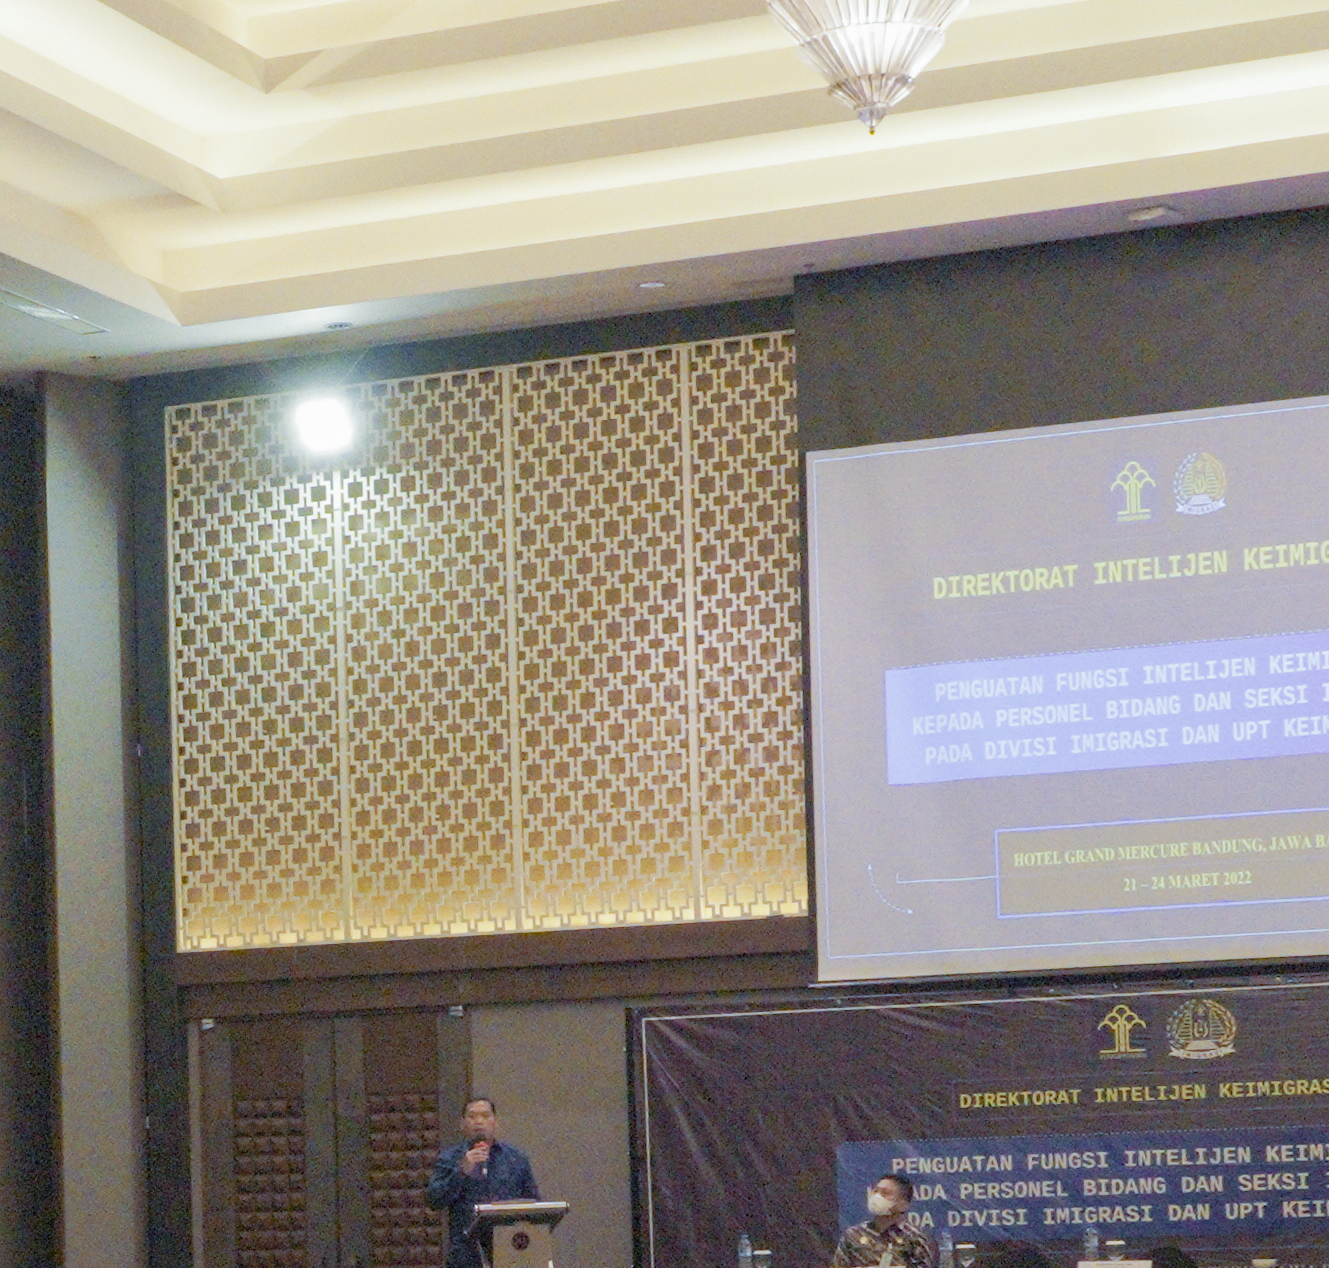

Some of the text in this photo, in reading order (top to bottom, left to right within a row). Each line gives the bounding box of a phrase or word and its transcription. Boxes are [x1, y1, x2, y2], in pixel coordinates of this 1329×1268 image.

[933, 564, 1079, 599] DIREKTORAT
[1094, 550, 1228, 584] INTELIJEN
[935, 675, 1043, 701] PENGUATAN
[1056, 668, 1129, 691] FUNGSI
[1143, 657, 1256, 685] INTELIJEN
[912, 711, 984, 735] KEPADA
[996, 703, 1093, 727] PERSONEL
[1106, 695, 1181, 719] BIDANG
[1194, 691, 1231, 712] DAN
[1244, 685, 1308, 709] SEKSI
[925, 743, 973, 764] PADA
[985, 737, 1057, 760] DIVISI
[1071, 728, 1168, 754] IMIGRASI
[1182, 723, 1219, 745] DAN
[1232, 720, 1271, 742] UPT
[1014, 851, 1061, 867] HOTEL
[1065, 847, 1115, 864] GRAND
[1119, 842, 1188, 860] MERCURE
[1192, 838, 1267, 856] BANDUNG,
[1269, 834, 1312, 851] JAWA
[1123, 878, 1137, 891] 21
[1152, 875, 1165, 890] 24
[1169, 872, 1220, 889] MARET
[1223, 871, 1252, 886] 2022
[960, 1089, 1081, 1109] DIREKTORAT
[1094, 1084, 1206, 1103] INTELIJEN
[892, 1154, 1013, 1175] PENGUATAN
[1027, 1151, 1108, 1170] FUNGSI
[1125, 1145, 1251, 1168] INTELIJEN
[960, 1180, 1069, 1200] PERSONEL
[1083, 1177, 1167, 1197] BIDANG
[1181, 1174, 1223, 1193] DAN
[1238, 1172, 1309, 1191] SEKSI
[948, 1208, 1028, 1227] DIVISI
[1043, 1205, 1153, 1225] IMIGRASI
[1169, 1202, 1210, 1222] DAN
[1225, 1201, 1268, 1220] UPT
